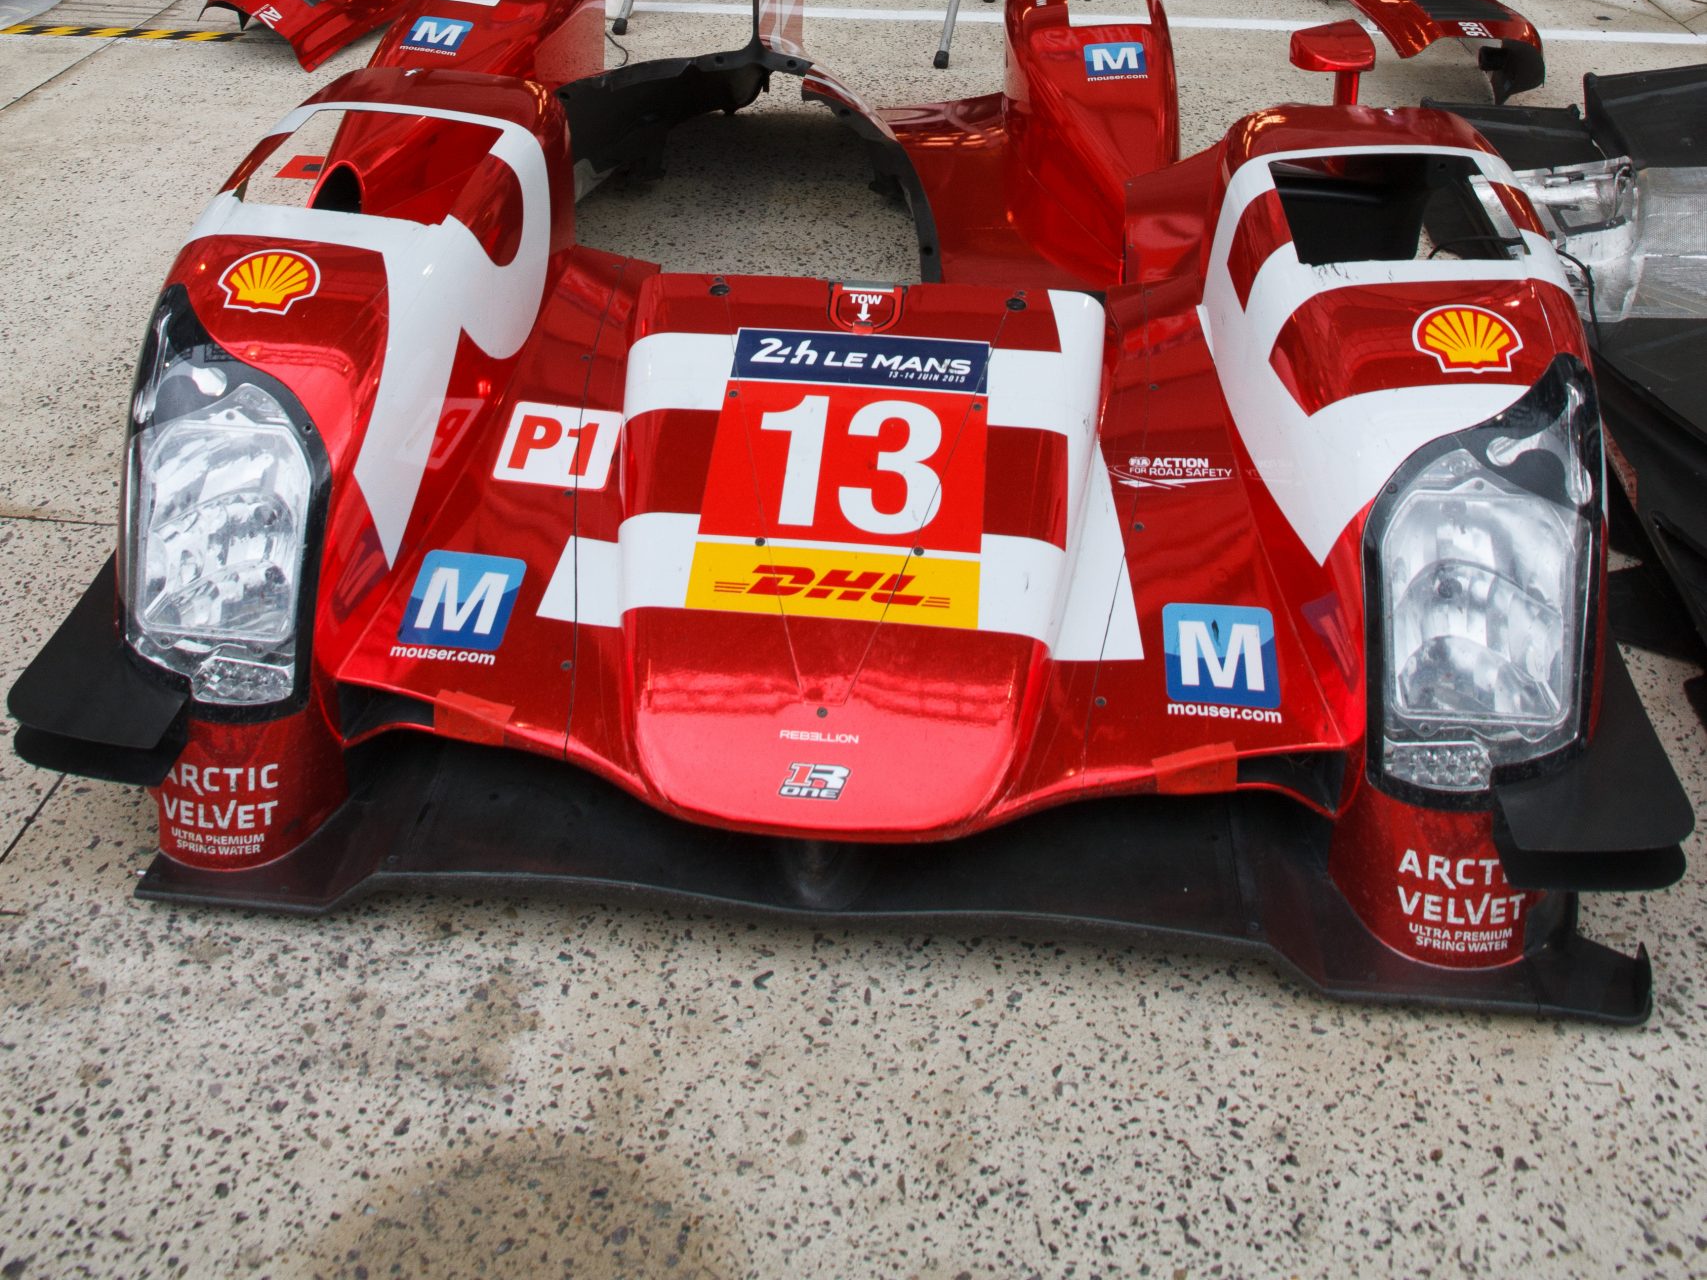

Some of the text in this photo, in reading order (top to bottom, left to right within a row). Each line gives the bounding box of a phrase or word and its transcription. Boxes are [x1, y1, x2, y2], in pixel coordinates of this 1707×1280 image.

[412, 21, 464, 46] M
[399, 45, 457, 57] mouser.com
[1091, 47, 1139, 71] M
[1087, 74, 1149, 82] mouser.com
[850, 294, 882, 305] TOW
[824, 353, 868, 368] LE
[872, 354, 972, 375] MANS
[889, 371, 966, 383] 13-14 JUIN 2015
[507, 414, 600, 477] P1
[759, 395, 943, 535] 13
[1129, 457, 1209, 468] FIA ACTION
[1149, 467, 1182, 476] ROAD
[1185, 468, 1232, 477] SAFETY
[746, 564, 925, 608] DHL
[414, 567, 510, 635] M
[389, 644, 496, 666] mouser.com
[1178, 620, 1266, 692] M
[1167, 702, 1283, 724] mouser.com
[779, 729, 859, 744] REBELLION
[162, 792, 278, 830] VELVET
[171, 826, 265, 845] ULTRA PREMIUM
[176, 839, 261, 855] SPRING WATER
[1398, 848, 1508, 890] ARCT
[1397, 885, 1526, 925] VELVET
[1408, 922, 1513, 942] ULTRA PREMIUM
[1415, 936, 1508, 952] SPRING WATER
